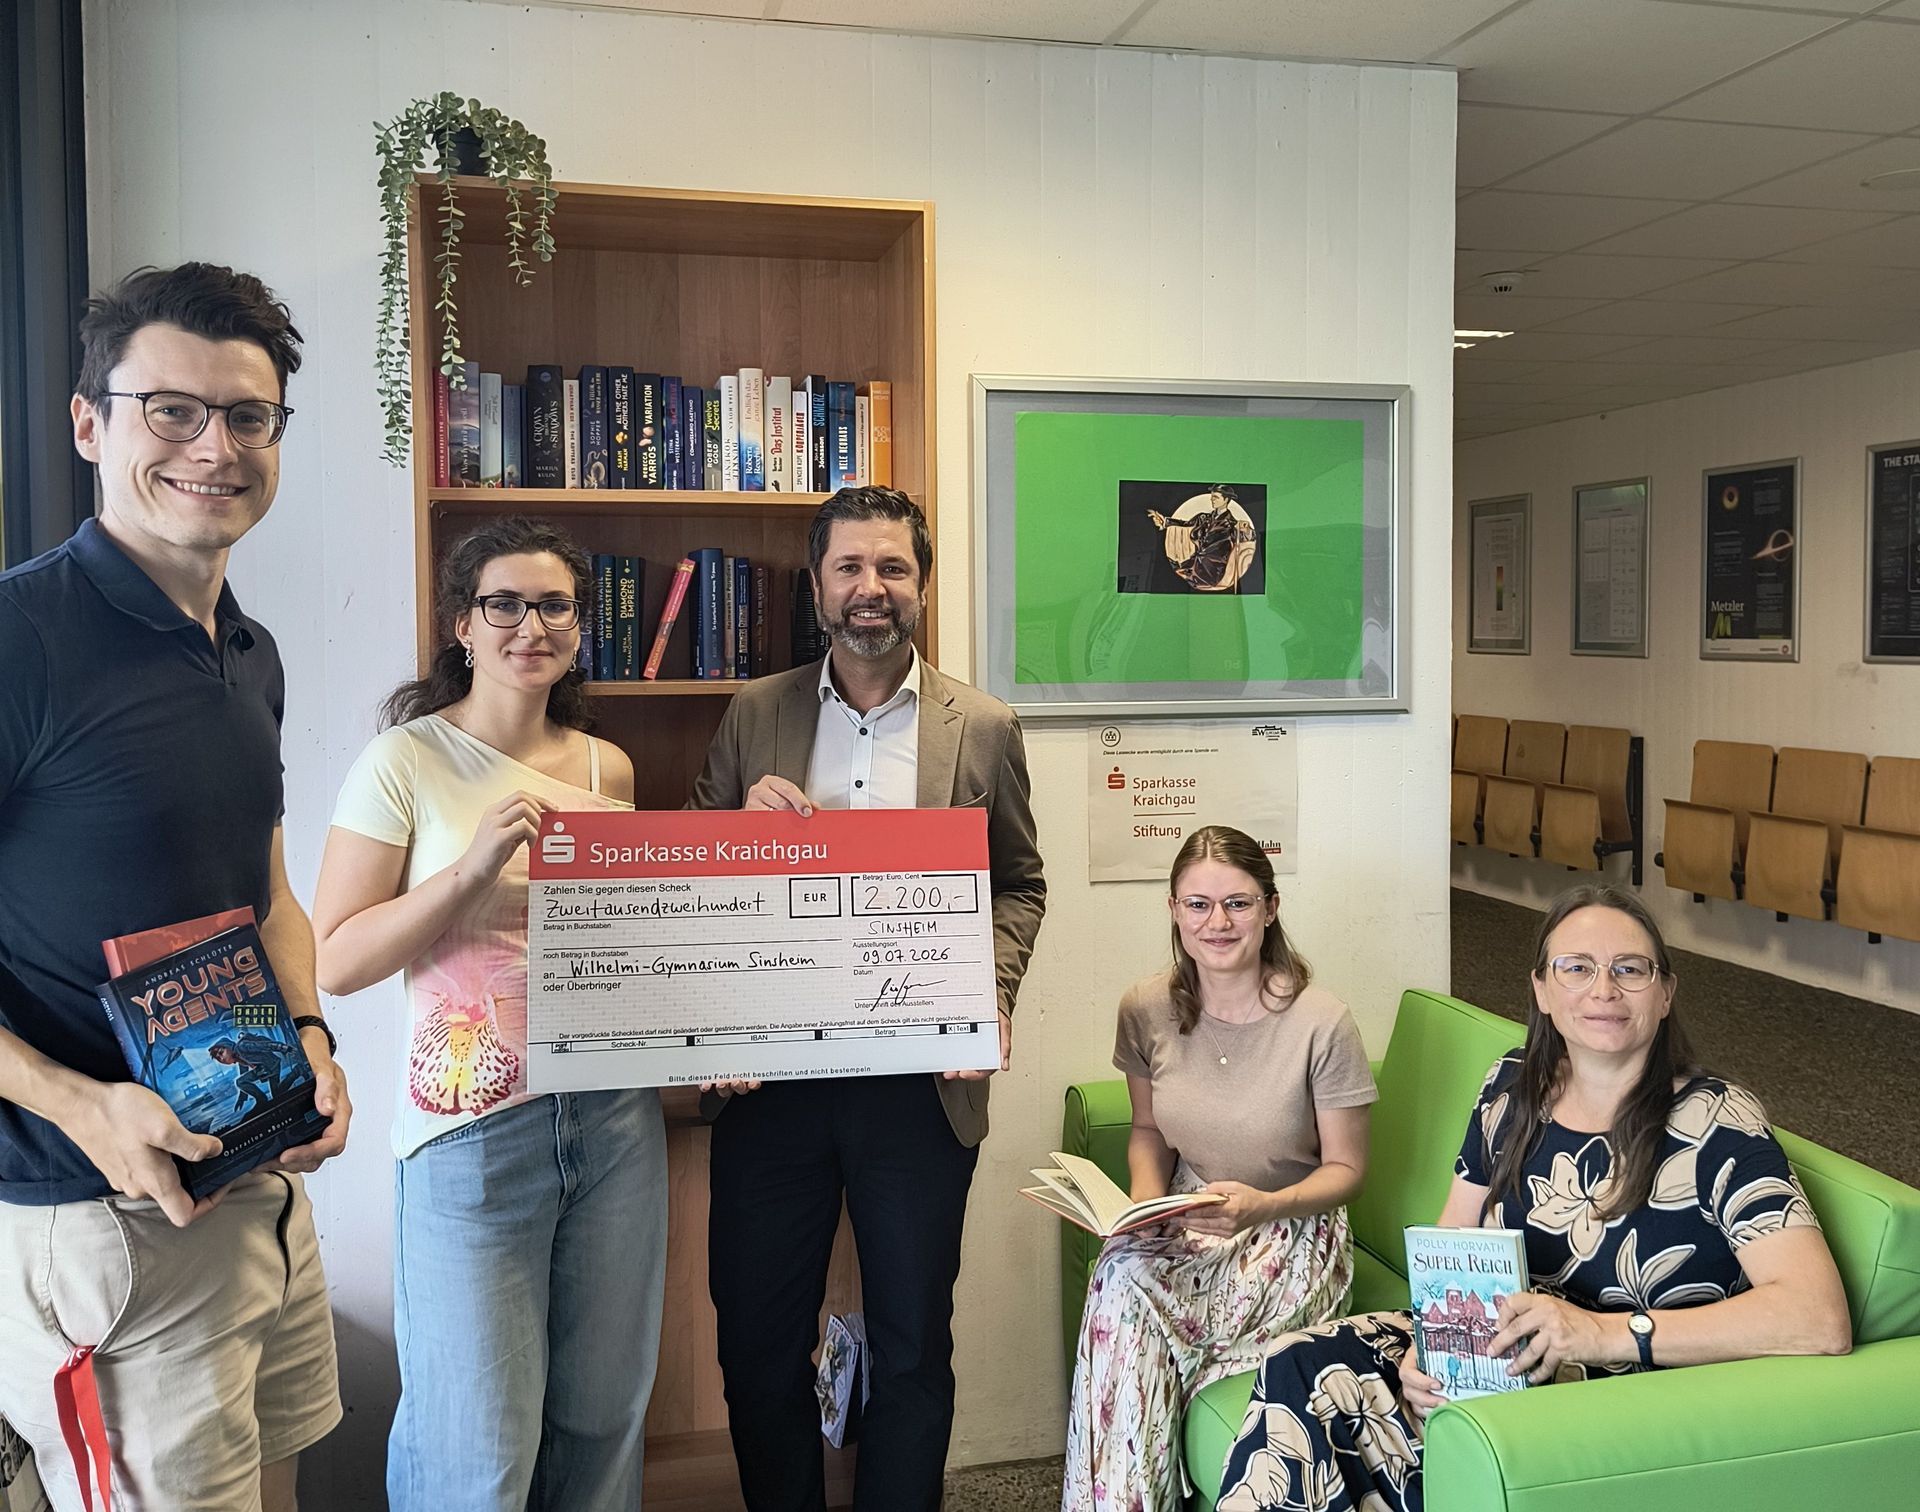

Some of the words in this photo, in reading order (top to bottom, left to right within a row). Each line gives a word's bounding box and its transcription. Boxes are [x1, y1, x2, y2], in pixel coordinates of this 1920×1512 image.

[621, 373, 628, 384] ME
[752, 378, 760, 400] Leben
[644, 384, 653, 425] VARIATION
[744, 393, 752, 420] Endlich
[813, 393, 825, 426] SCHMERZ
[534, 406, 545, 442] CROWN
[548, 400, 560, 443] SHADOWS
[704, 400, 713, 430] Twelve
[712, 400, 720, 431] Secrets
[770, 408, 783, 438] Institut
[770, 439, 783, 455] Das
[838, 426, 848, 454] NEUHAUS
[648, 446, 658, 484] YARROS
[838, 456, 848, 470] NELE
[1883, 456, 1902, 468] THE
[620, 578, 628, 618] DIAMOND
[1712, 600, 1744, 612] Metzler
[1133, 776, 1196, 791] Sparkasse
[1134, 794, 1196, 808] Kraichgau
[1134, 824, 1182, 838] Stiftung
[590, 842, 708, 868] Sparkasse
[716, 839, 828, 865] Kraichgau
[544, 886, 576, 894] Zahlen
[578, 885, 593, 894] Sie
[596, 886, 624, 896] gegen
[626, 884, 656, 893] diesen
[658, 884, 692, 892] Scheck
[804, 892, 828, 902] EUR
[864, 886, 965, 911] 2.200,-
[546, 892, 766, 918] Zweitausendzweihundert
[574, 922, 612, 930] Buchstaben
[868, 920, 937, 936] SINSHEIM
[591, 950, 628, 958] Buchstaben
[863, 947, 951, 964] 09.07.2026
[570, 956, 740, 978] Wilhelmi-Gymnasium
[748, 950, 816, 968] Sinsheim
[130, 946, 260, 1016] YOUNG
[145, 964, 186, 987] ANDREAS
[543, 982, 564, 992] oder
[568, 981, 622, 991] Überbringer
[148, 968, 266, 1044] AGENTS
[674, 1027, 699, 1035] geändert
[780, 1022, 802, 1030] Angabe
[820, 1020, 856, 1028] Zahlungsfrist
[874, 1029, 896, 1037] Betrag
[956, 1024, 970, 1032] Text
[611, 1040, 648, 1048] Scheck-Nr.
[688, 1074, 712, 1082] dieses
[752, 1070, 792, 1078] beschriften
[830, 1066, 871, 1074] bestempeln
[224, 1132, 264, 1156] Operation
[1416, 1238, 1448, 1250] POLLY
[1454, 1240, 1504, 1253] HORVATH
[1414, 1253, 1463, 1274] SUPER
[1468, 1254, 1513, 1275] REICH
